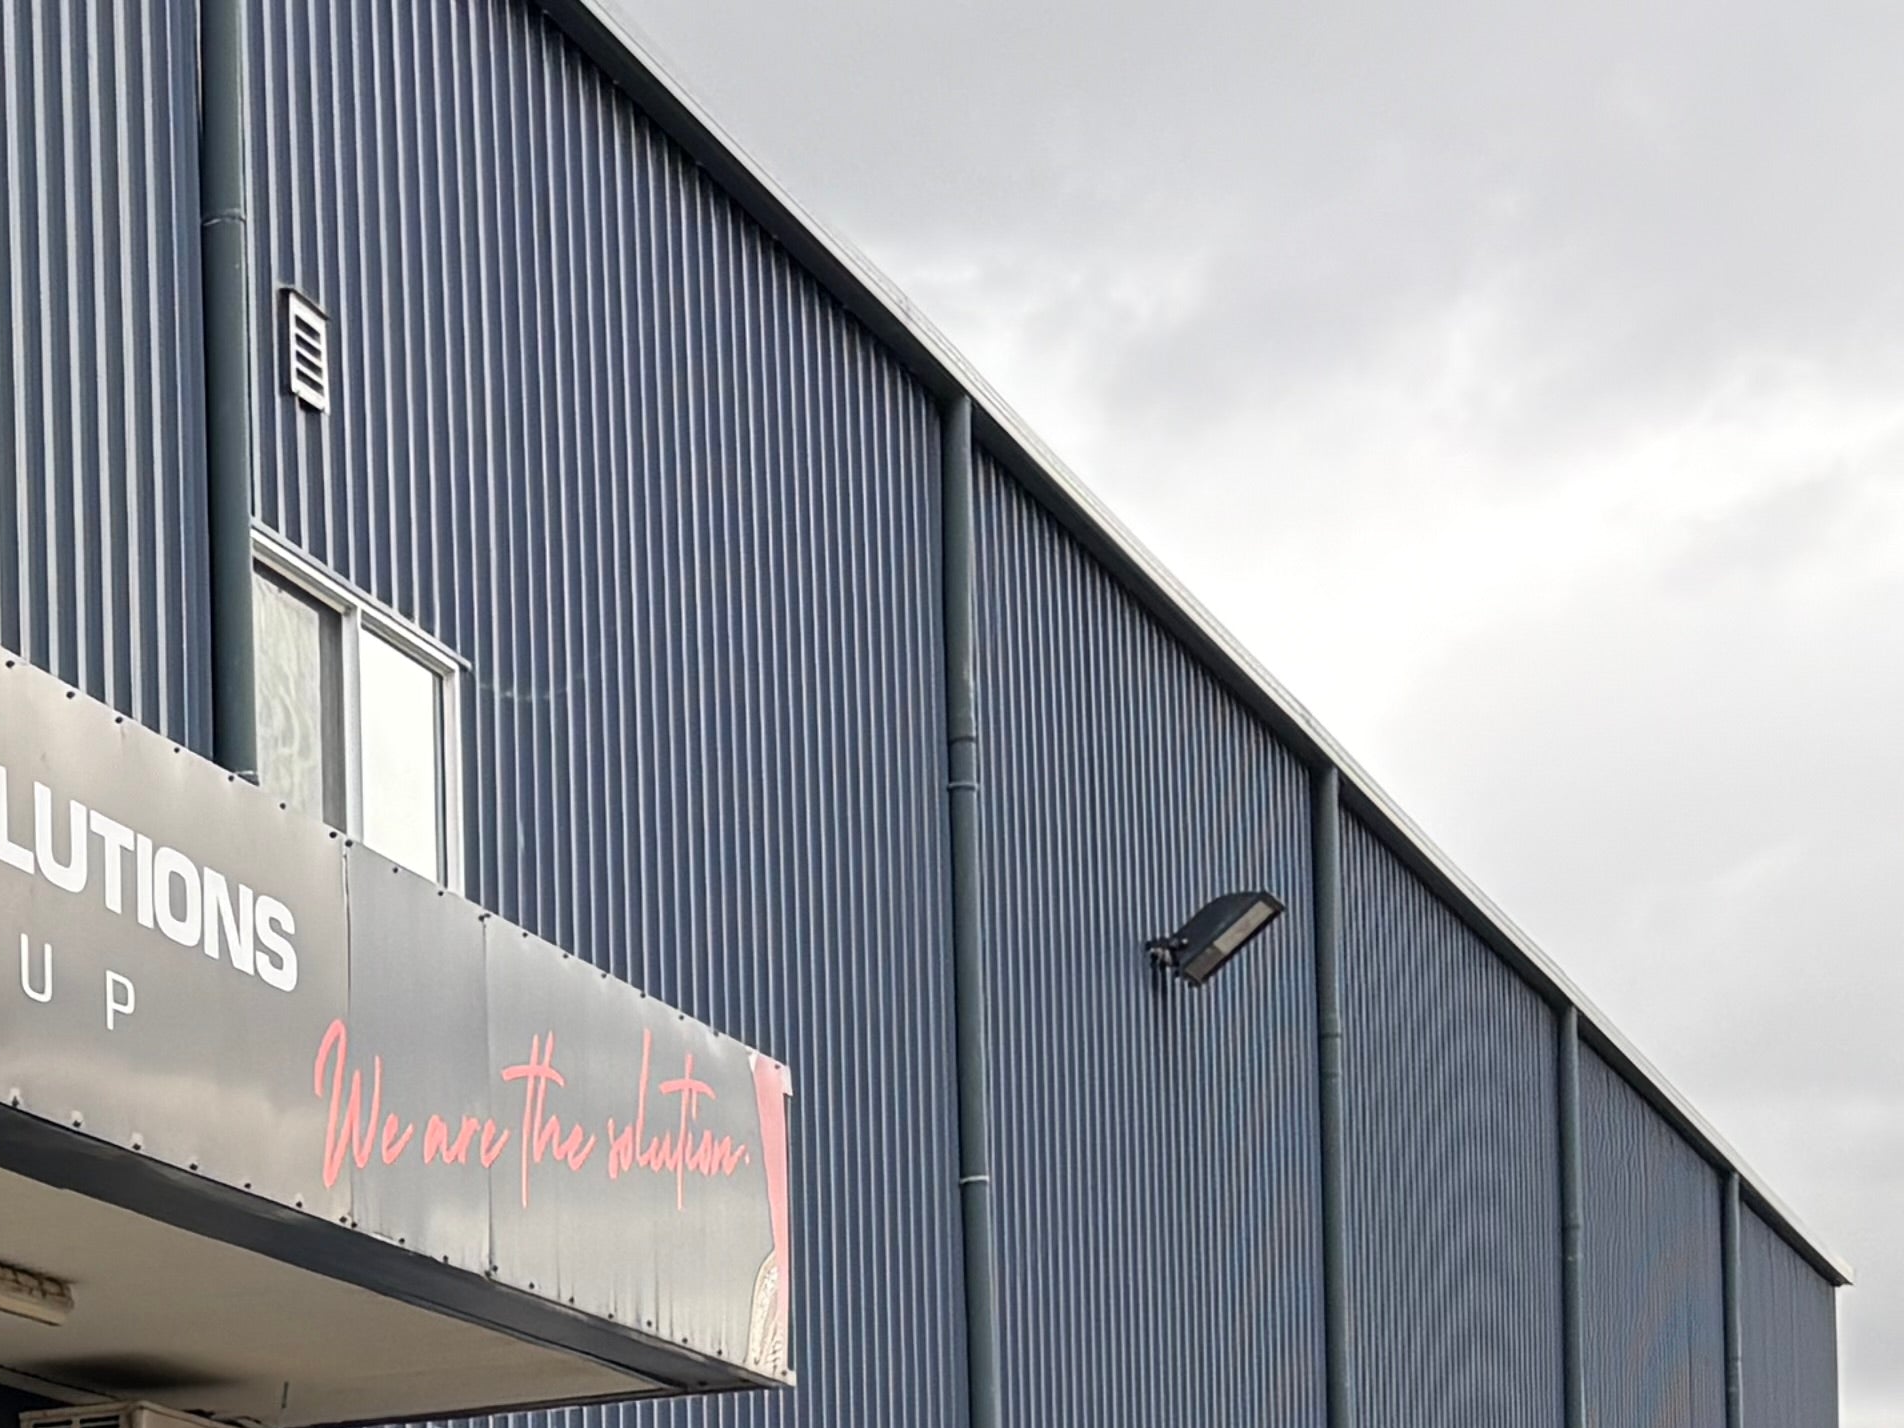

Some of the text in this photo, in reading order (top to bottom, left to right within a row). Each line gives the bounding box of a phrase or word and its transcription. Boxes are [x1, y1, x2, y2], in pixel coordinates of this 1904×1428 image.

[313, 1018, 416, 1190] We
[423, 1113, 510, 1169] are
[500, 1029, 596, 1203] the
